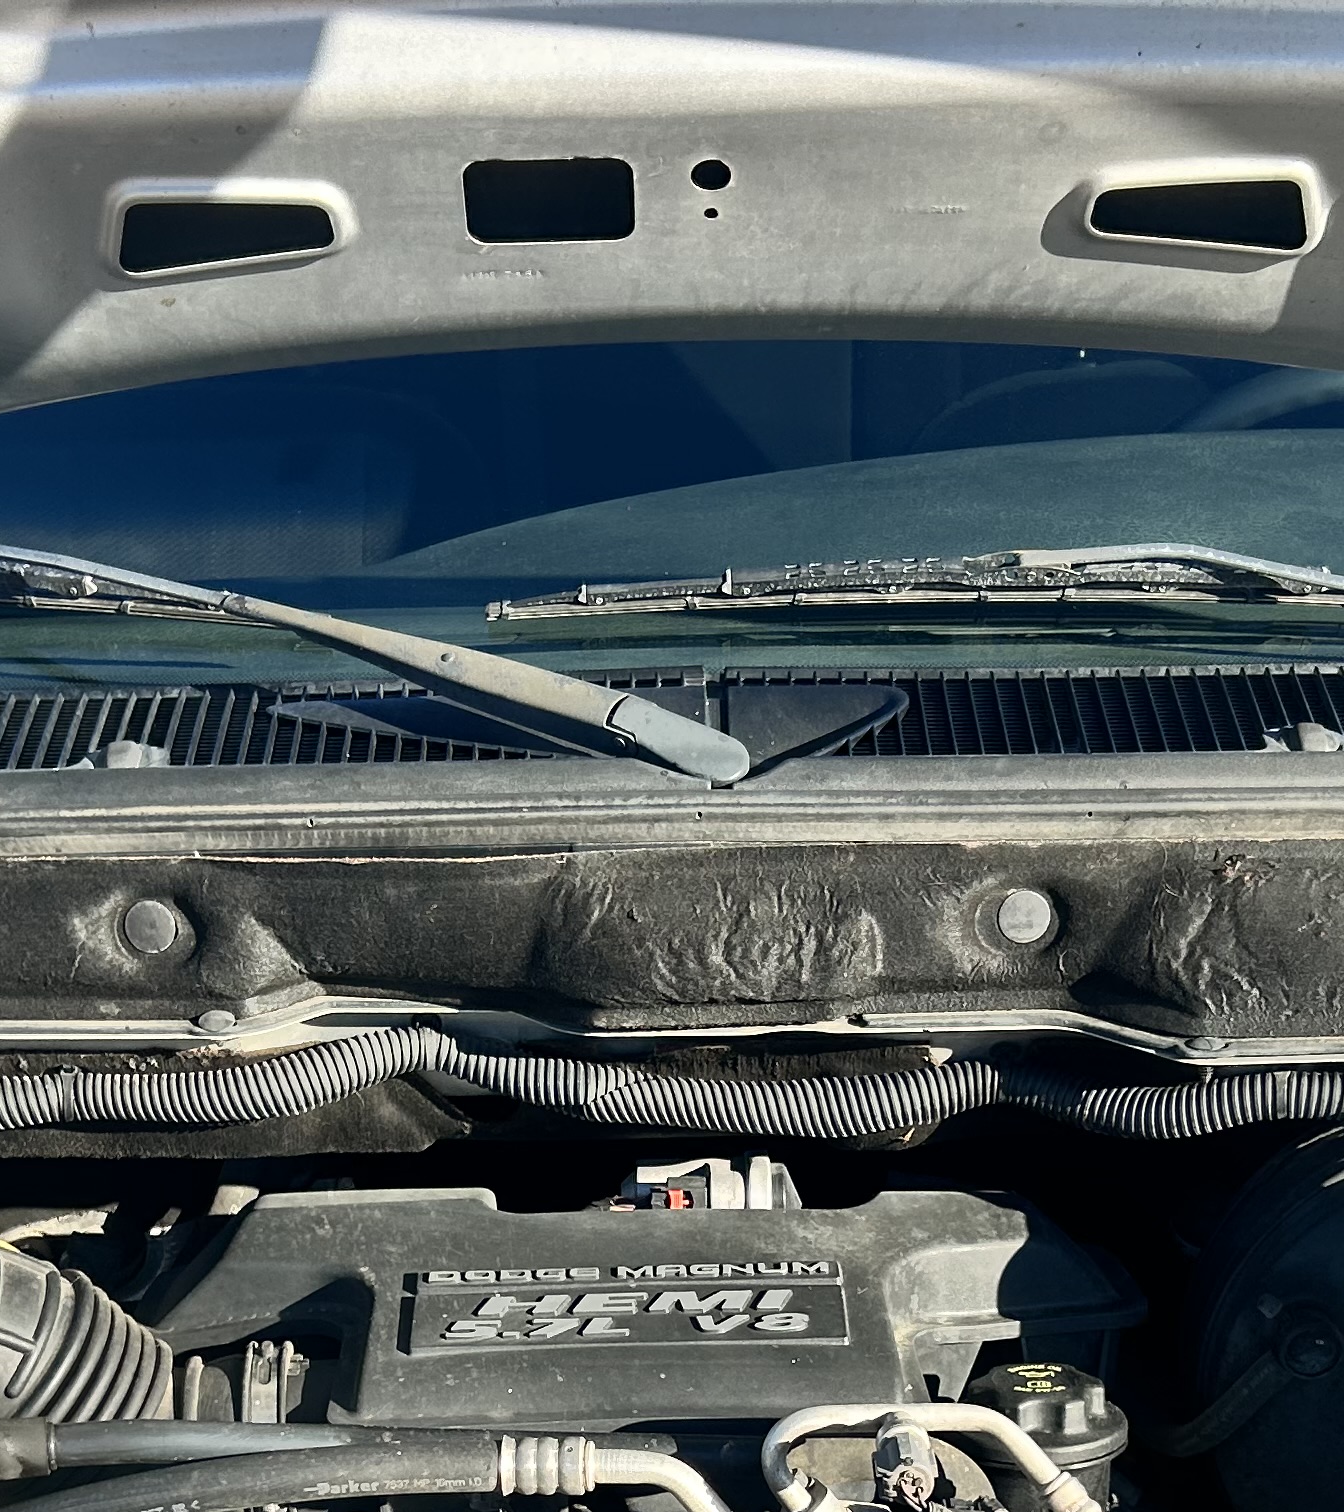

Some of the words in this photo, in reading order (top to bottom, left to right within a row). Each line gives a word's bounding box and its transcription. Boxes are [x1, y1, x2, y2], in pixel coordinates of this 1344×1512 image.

[427, 1266, 600, 1283] DODGE
[616, 1260, 830, 1279] MAGNUM
[471, 1288, 794, 1317] HEMI
[443, 1316, 631, 1340] 5.7L
[693, 1311, 811, 1334] V8
[316, 1479, 380, 1496] Parker
